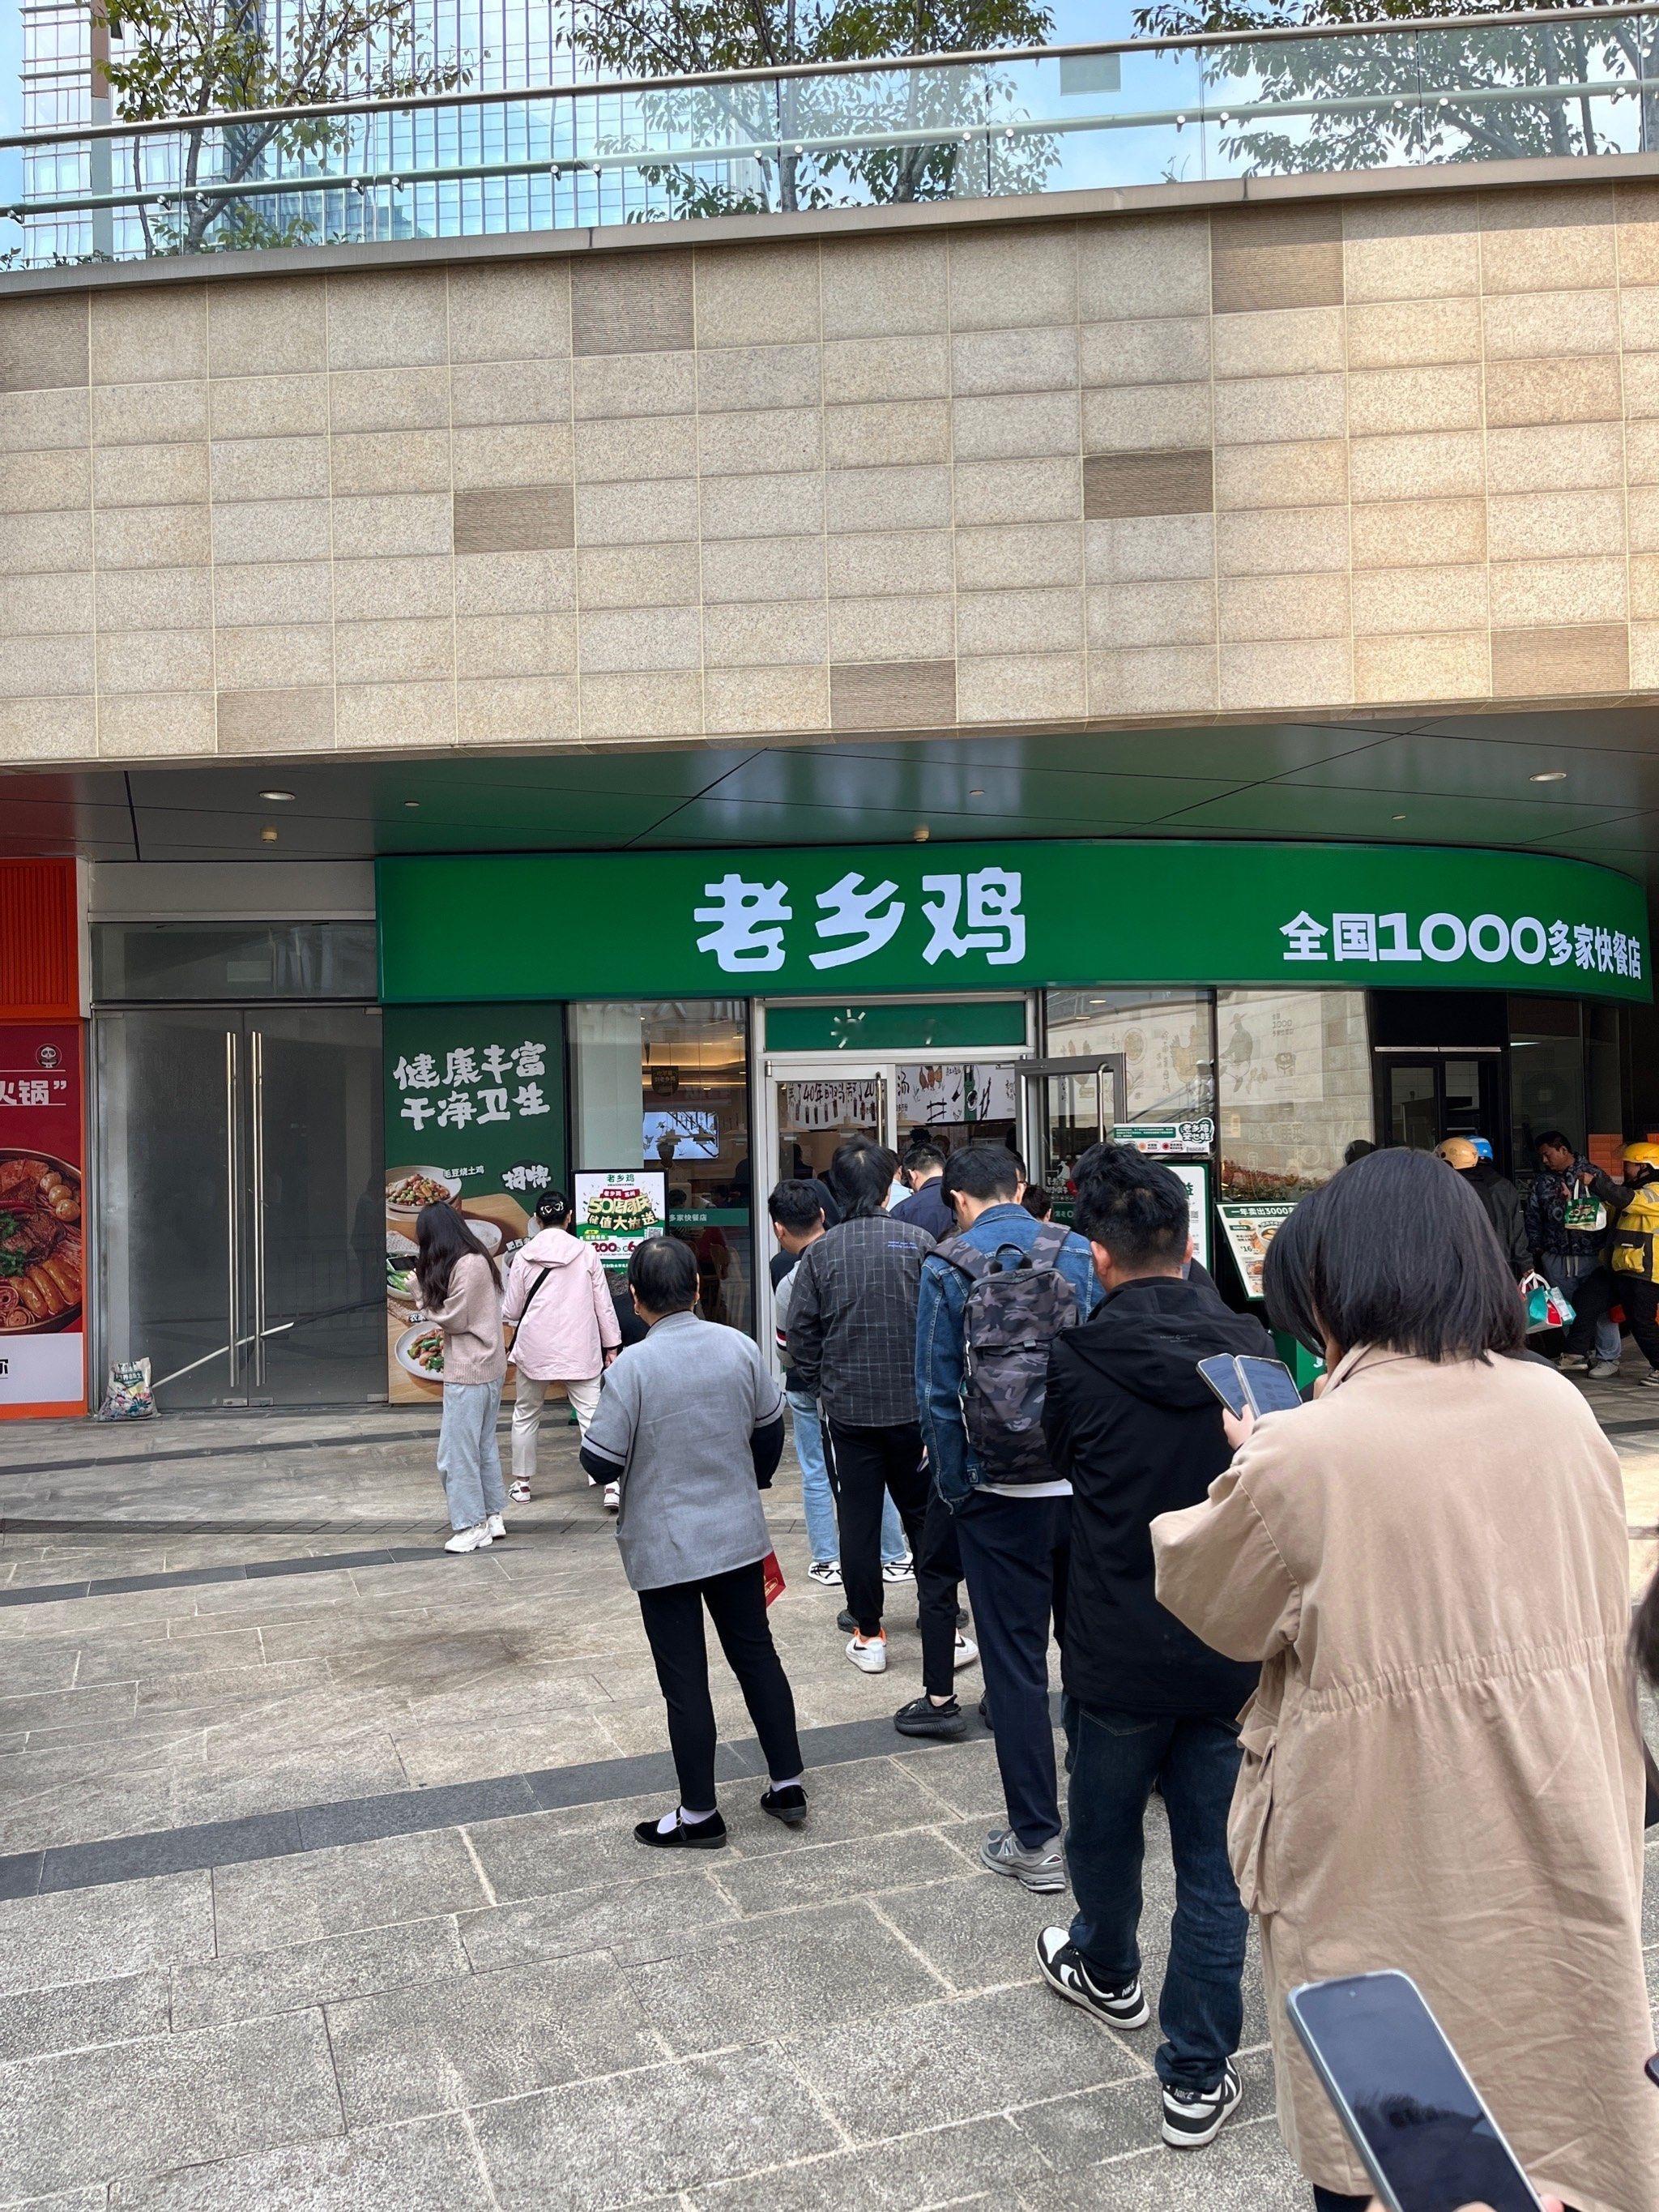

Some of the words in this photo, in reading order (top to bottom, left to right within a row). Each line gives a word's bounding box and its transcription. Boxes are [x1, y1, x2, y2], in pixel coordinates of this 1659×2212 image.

[693, 867, 1026, 972] 老乡鸡
[1279, 910, 1642, 980] 全国1000多家快餐店
[393, 1040, 547, 1091] 健康丰富
[400, 1082, 551, 1131] 干净卫生
[1183, 1123, 1209, 1133] 老乡鸡
[443, 1165, 484, 1178] 毛豆烧土鸡
[502, 1164, 551, 1190] 招牌
[607, 1173, 635, 1183] 老乡鸡
[669, 1213, 707, 1222] 多家快餐店
[1174, 2088, 1194, 2100] NIKE
